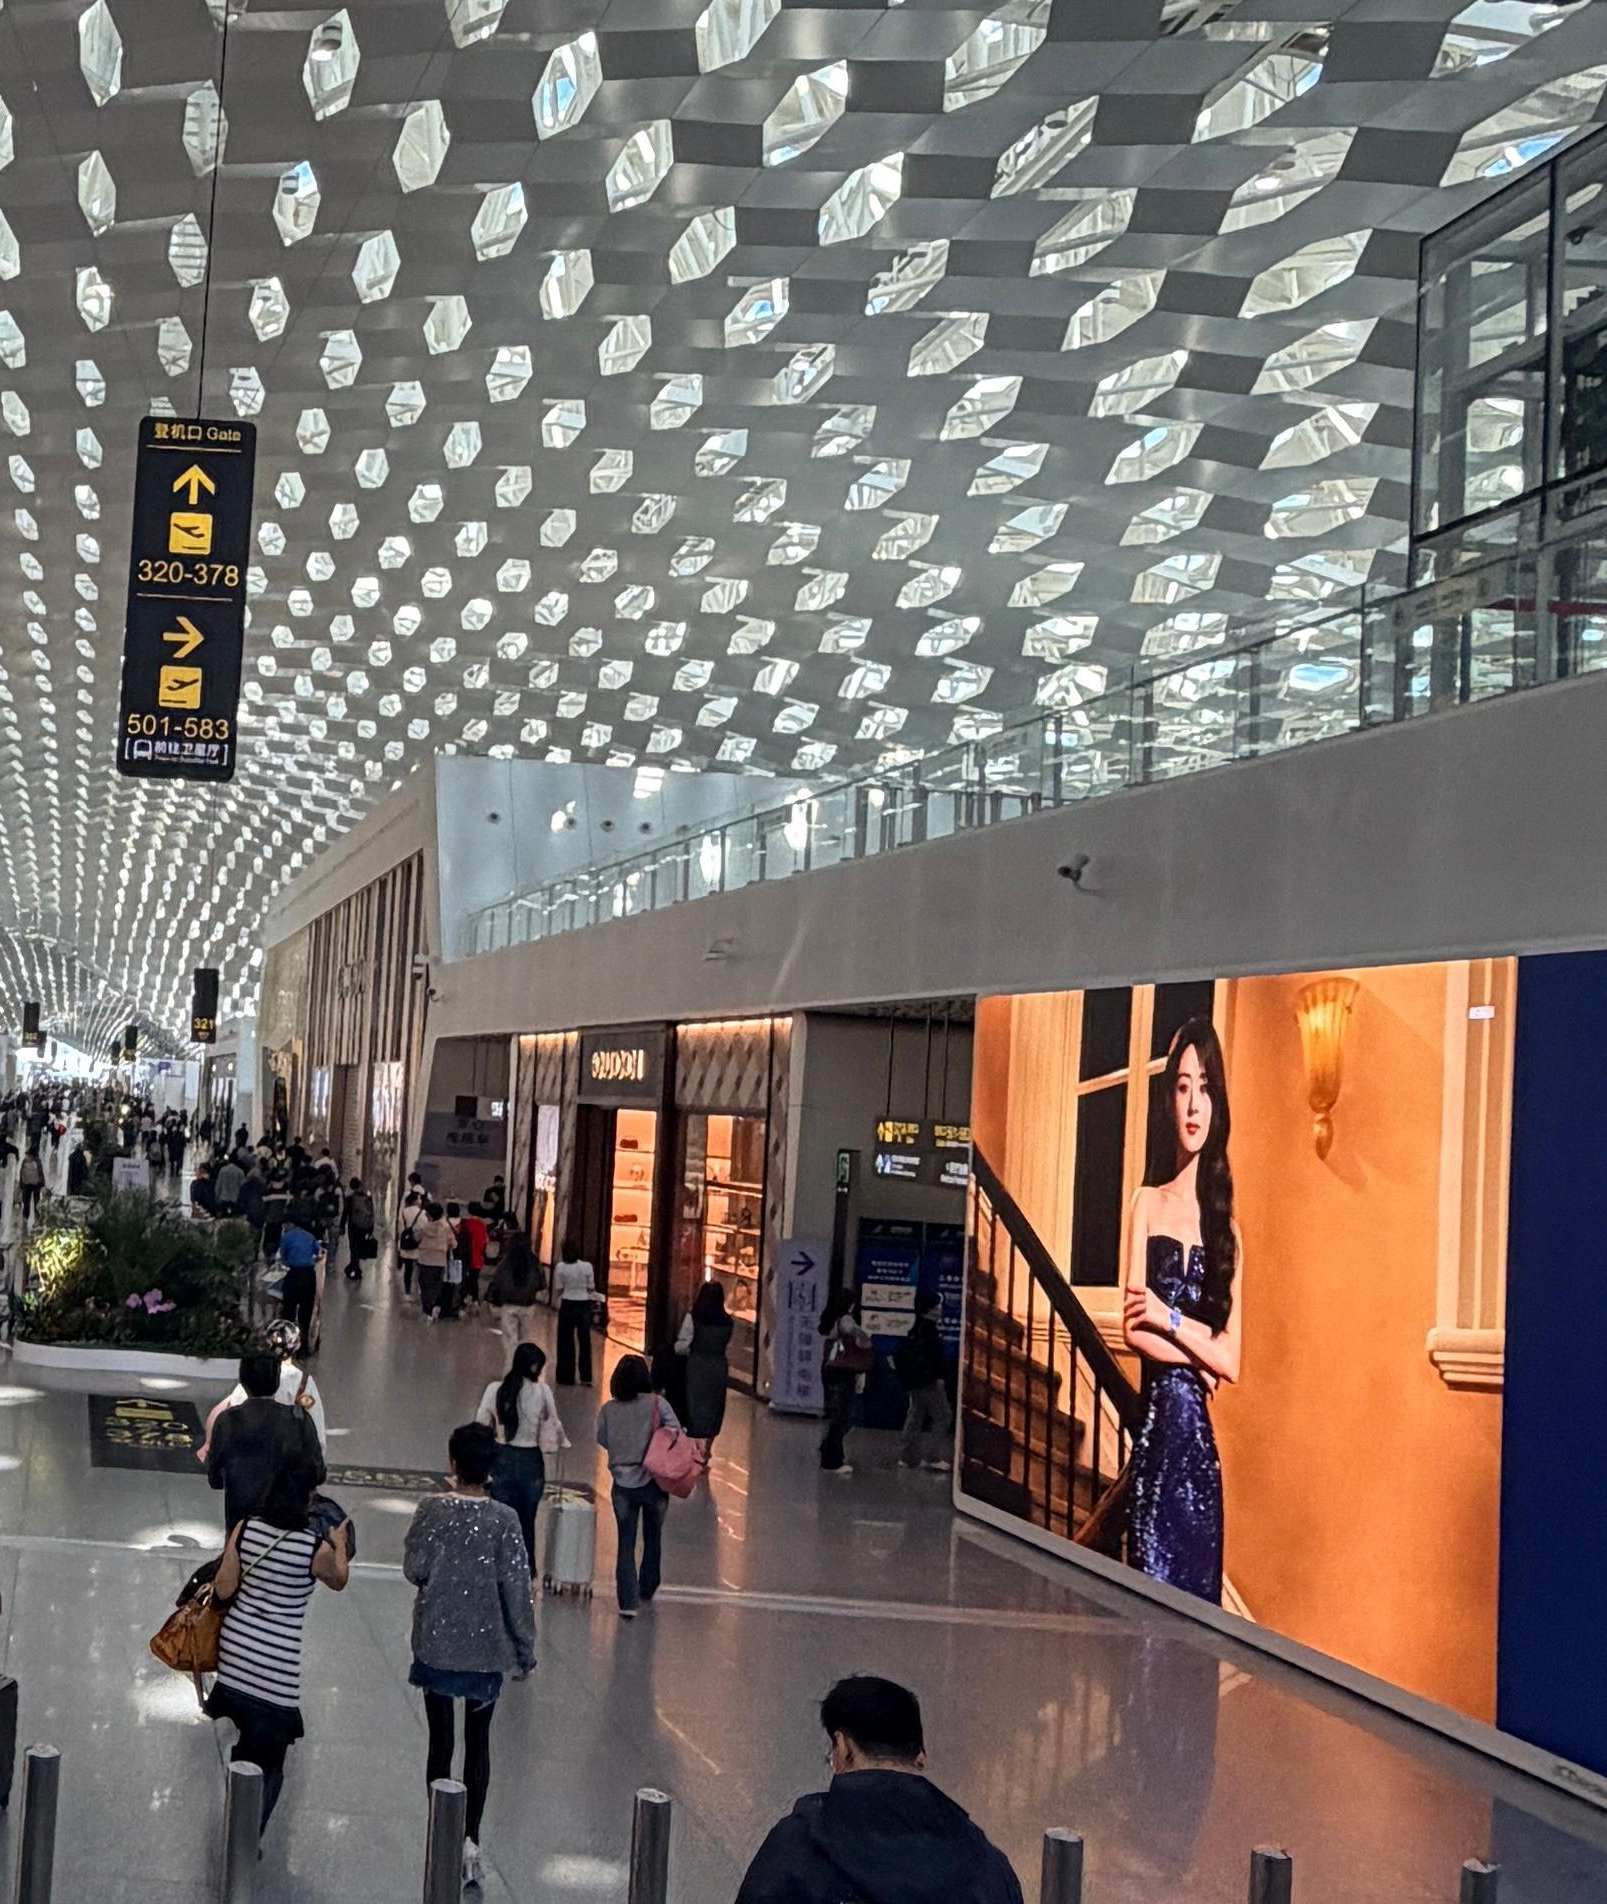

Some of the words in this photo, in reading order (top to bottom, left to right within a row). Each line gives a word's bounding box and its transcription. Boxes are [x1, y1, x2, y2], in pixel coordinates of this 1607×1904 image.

[137, 559, 240, 588] 320-378
[127, 713, 230, 740] 501-583
[193, 1017, 214, 1030] 321
